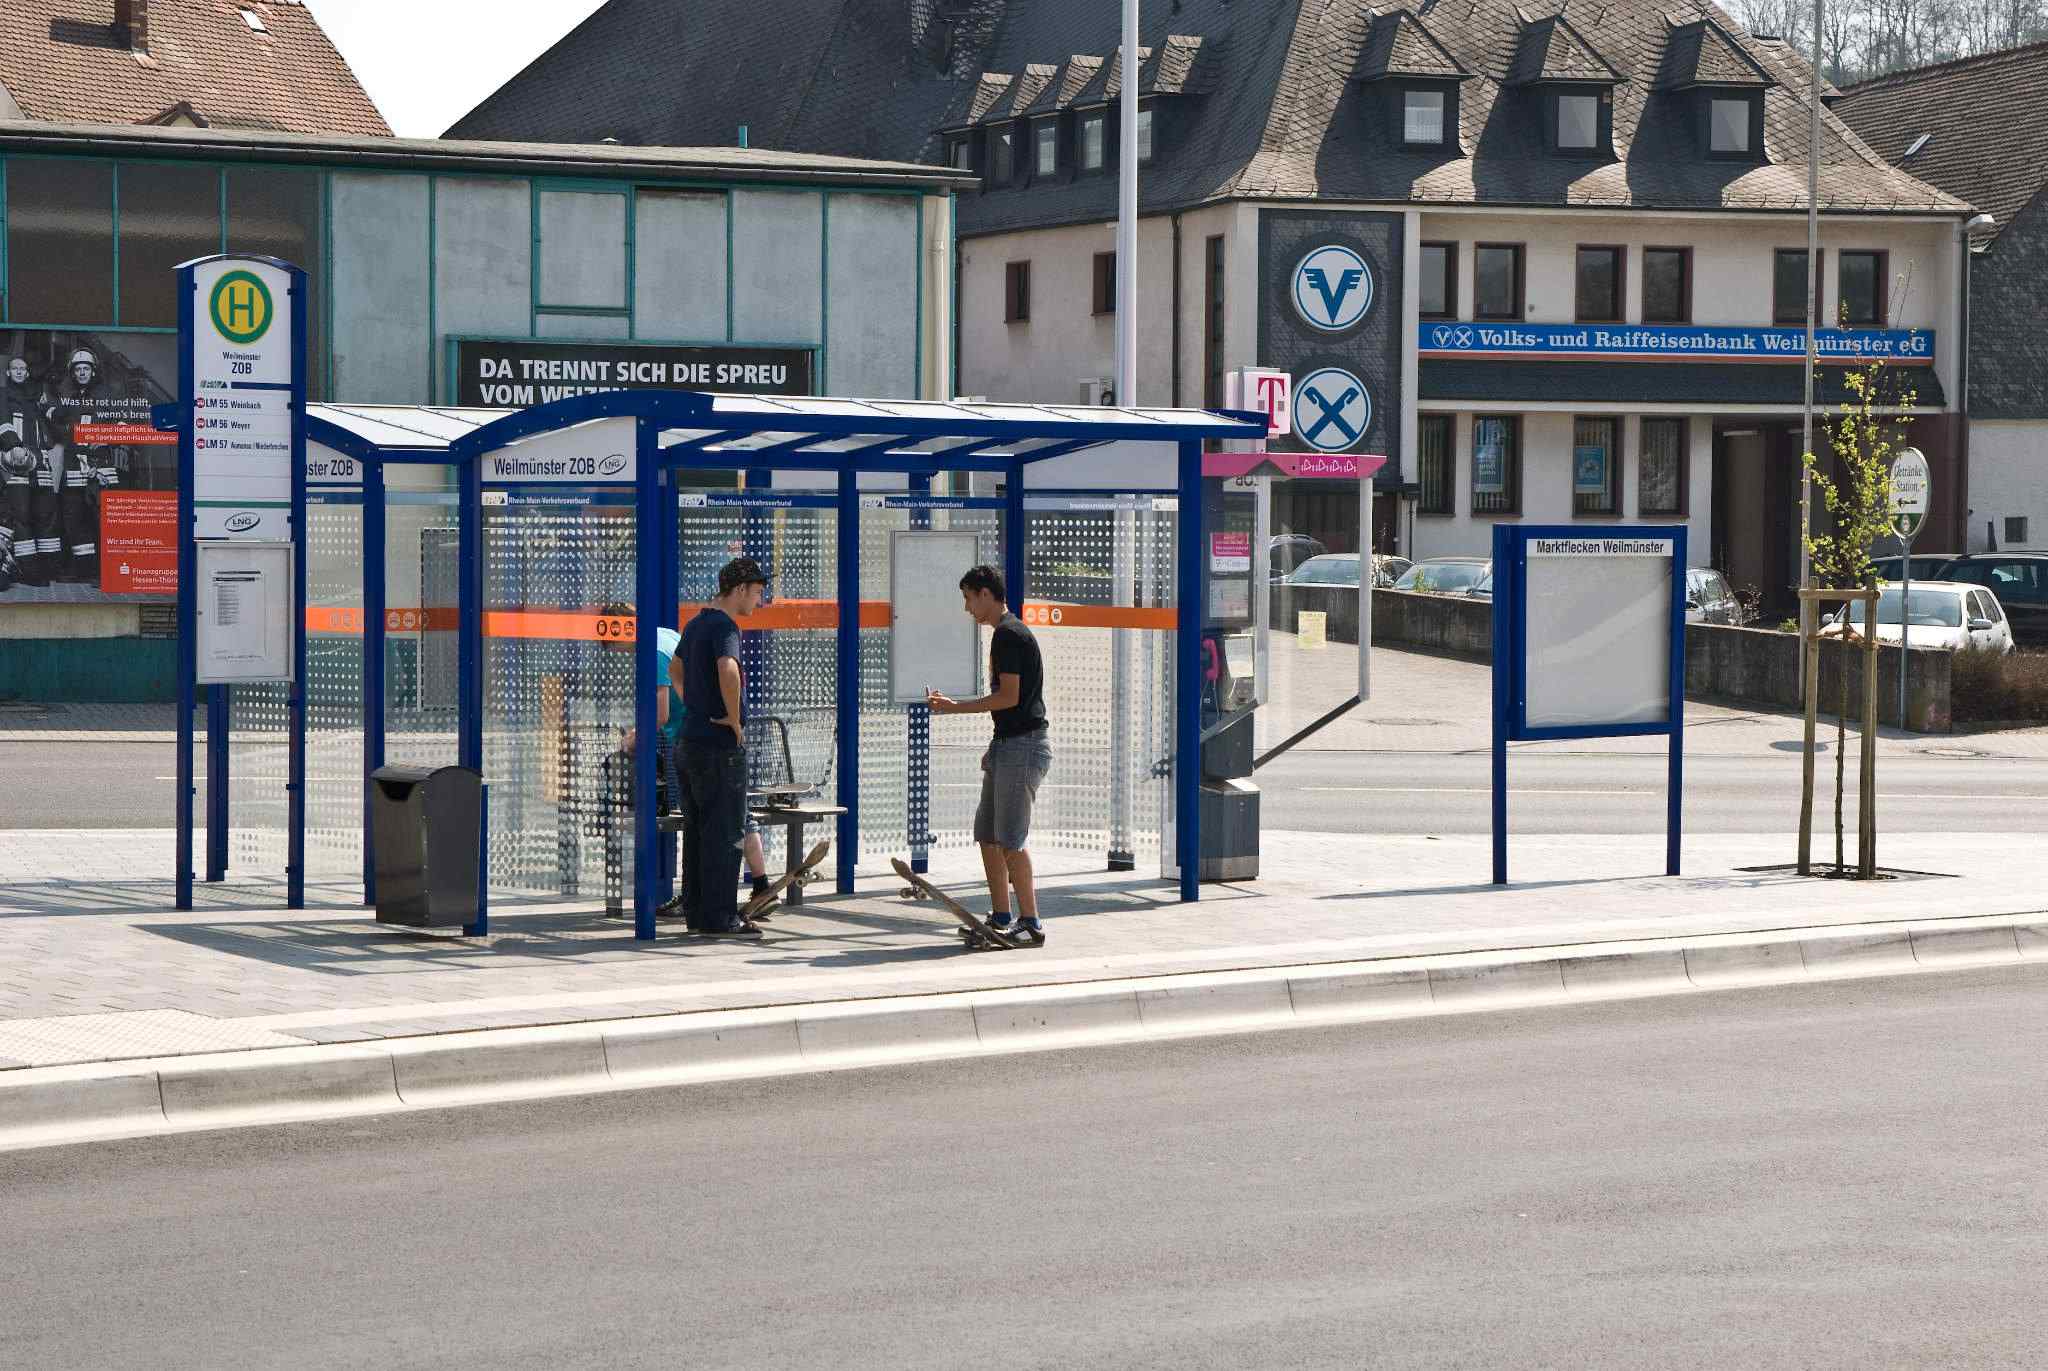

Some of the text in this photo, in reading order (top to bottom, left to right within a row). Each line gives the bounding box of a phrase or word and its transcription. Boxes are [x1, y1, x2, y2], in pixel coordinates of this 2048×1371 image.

[229, 287, 254, 329] H
[1478, 329, 1927, 353] Volks- und Raiffeisenbank Weilmünster eG
[231, 362, 252, 374] ZOB
[480, 358, 787, 385] DA TRENNT SICH DIE SPREU
[480, 383, 534, 405] VOM
[61, 397, 152, 408] Was ist rot und hilft,
[206, 400, 217, 408] LM
[219, 400, 228, 408] 55
[96, 410, 128, 419] wenn's
[206, 420, 217, 429] LM
[219, 420, 228, 429] 56
[206, 440, 217, 449] LM
[219, 440, 228, 449] 57
[331, 459, 354, 476] ZOB
[494, 457, 596, 475] Weilmünster ZOB
[1536, 540, 1664, 553] Marktflecken Weilmünster
